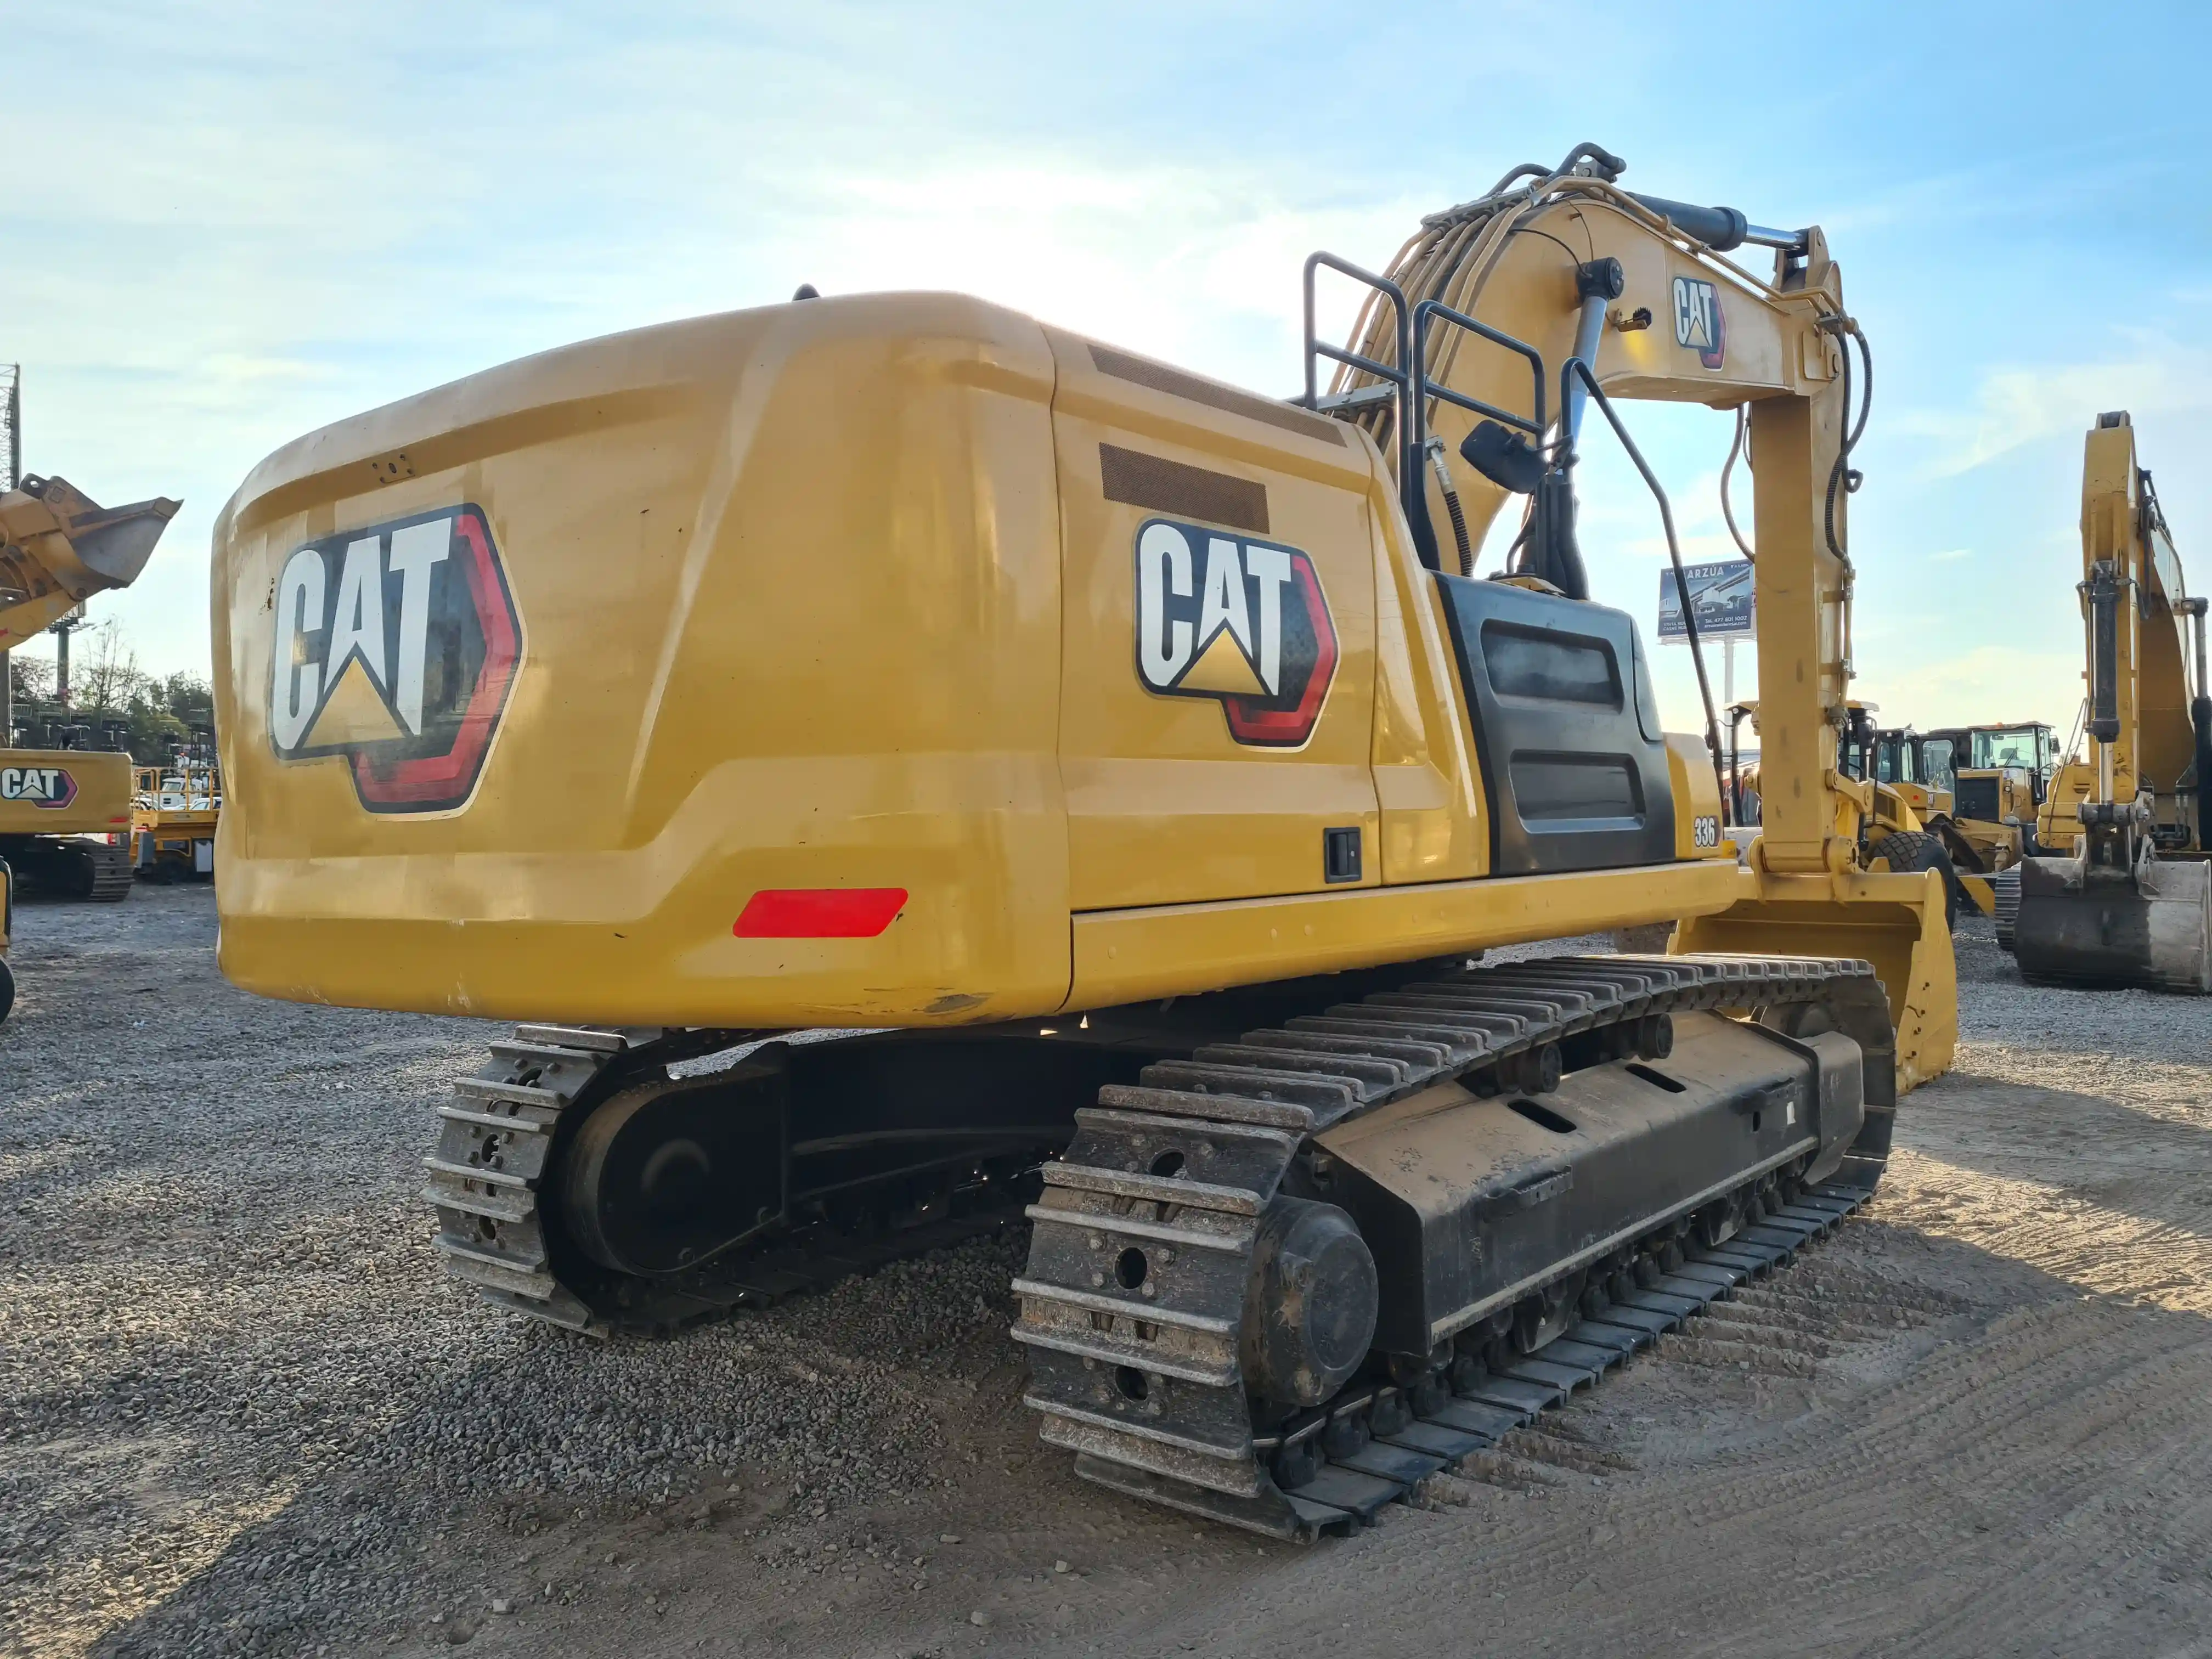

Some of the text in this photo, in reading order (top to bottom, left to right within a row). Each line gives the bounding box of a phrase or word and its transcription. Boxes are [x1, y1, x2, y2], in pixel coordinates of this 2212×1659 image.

[1673, 278, 1712, 347] CAT
[1687, 565, 1724, 579] ARZÚA
[273, 517, 452, 749] CAT
[1140, 524, 1291, 696] CAT
[2, 769, 59, 799] CAT
[1695, 817, 1715, 846] 336
